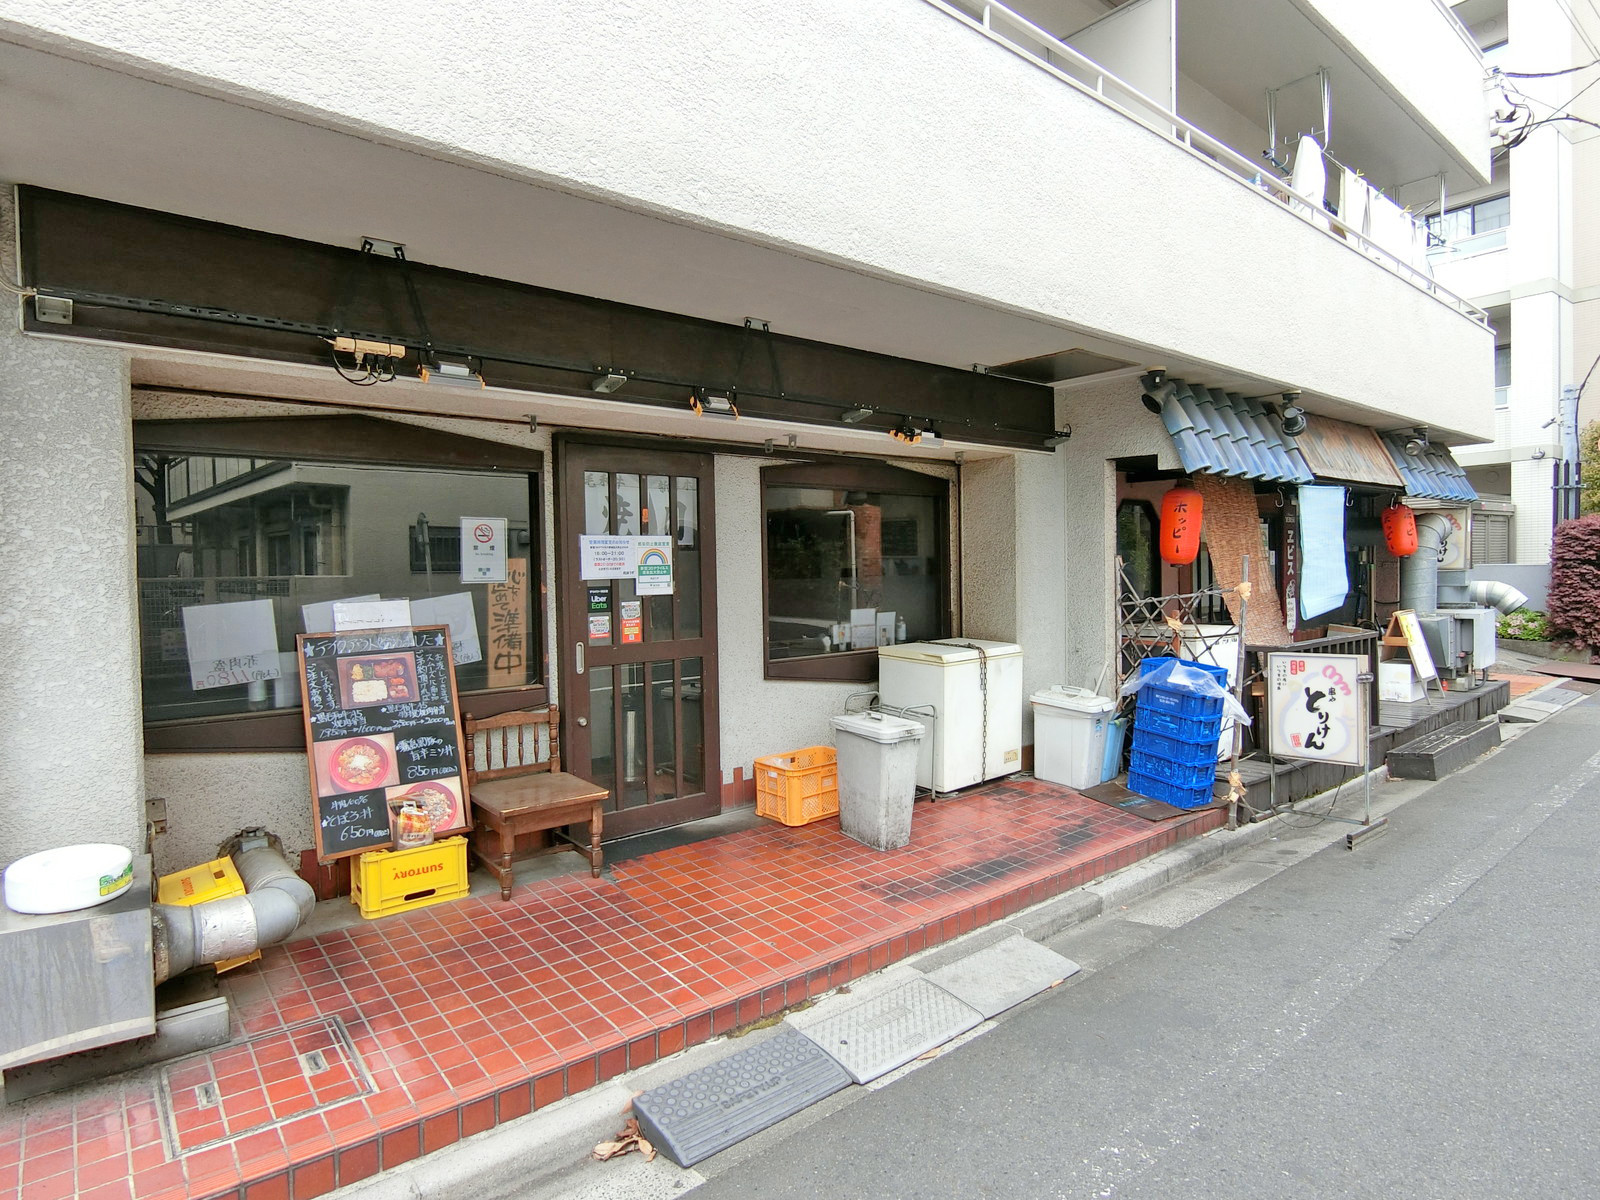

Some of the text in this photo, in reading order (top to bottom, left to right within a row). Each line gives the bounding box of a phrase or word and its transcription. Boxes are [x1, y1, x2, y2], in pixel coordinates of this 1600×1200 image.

[1173, 502, 1188, 553] ホッピー
[491, 609, 522, 674] 準備中
[1304, 687, 1331, 750] とりけん
[393, 862, 444, 880] SUNTORY
